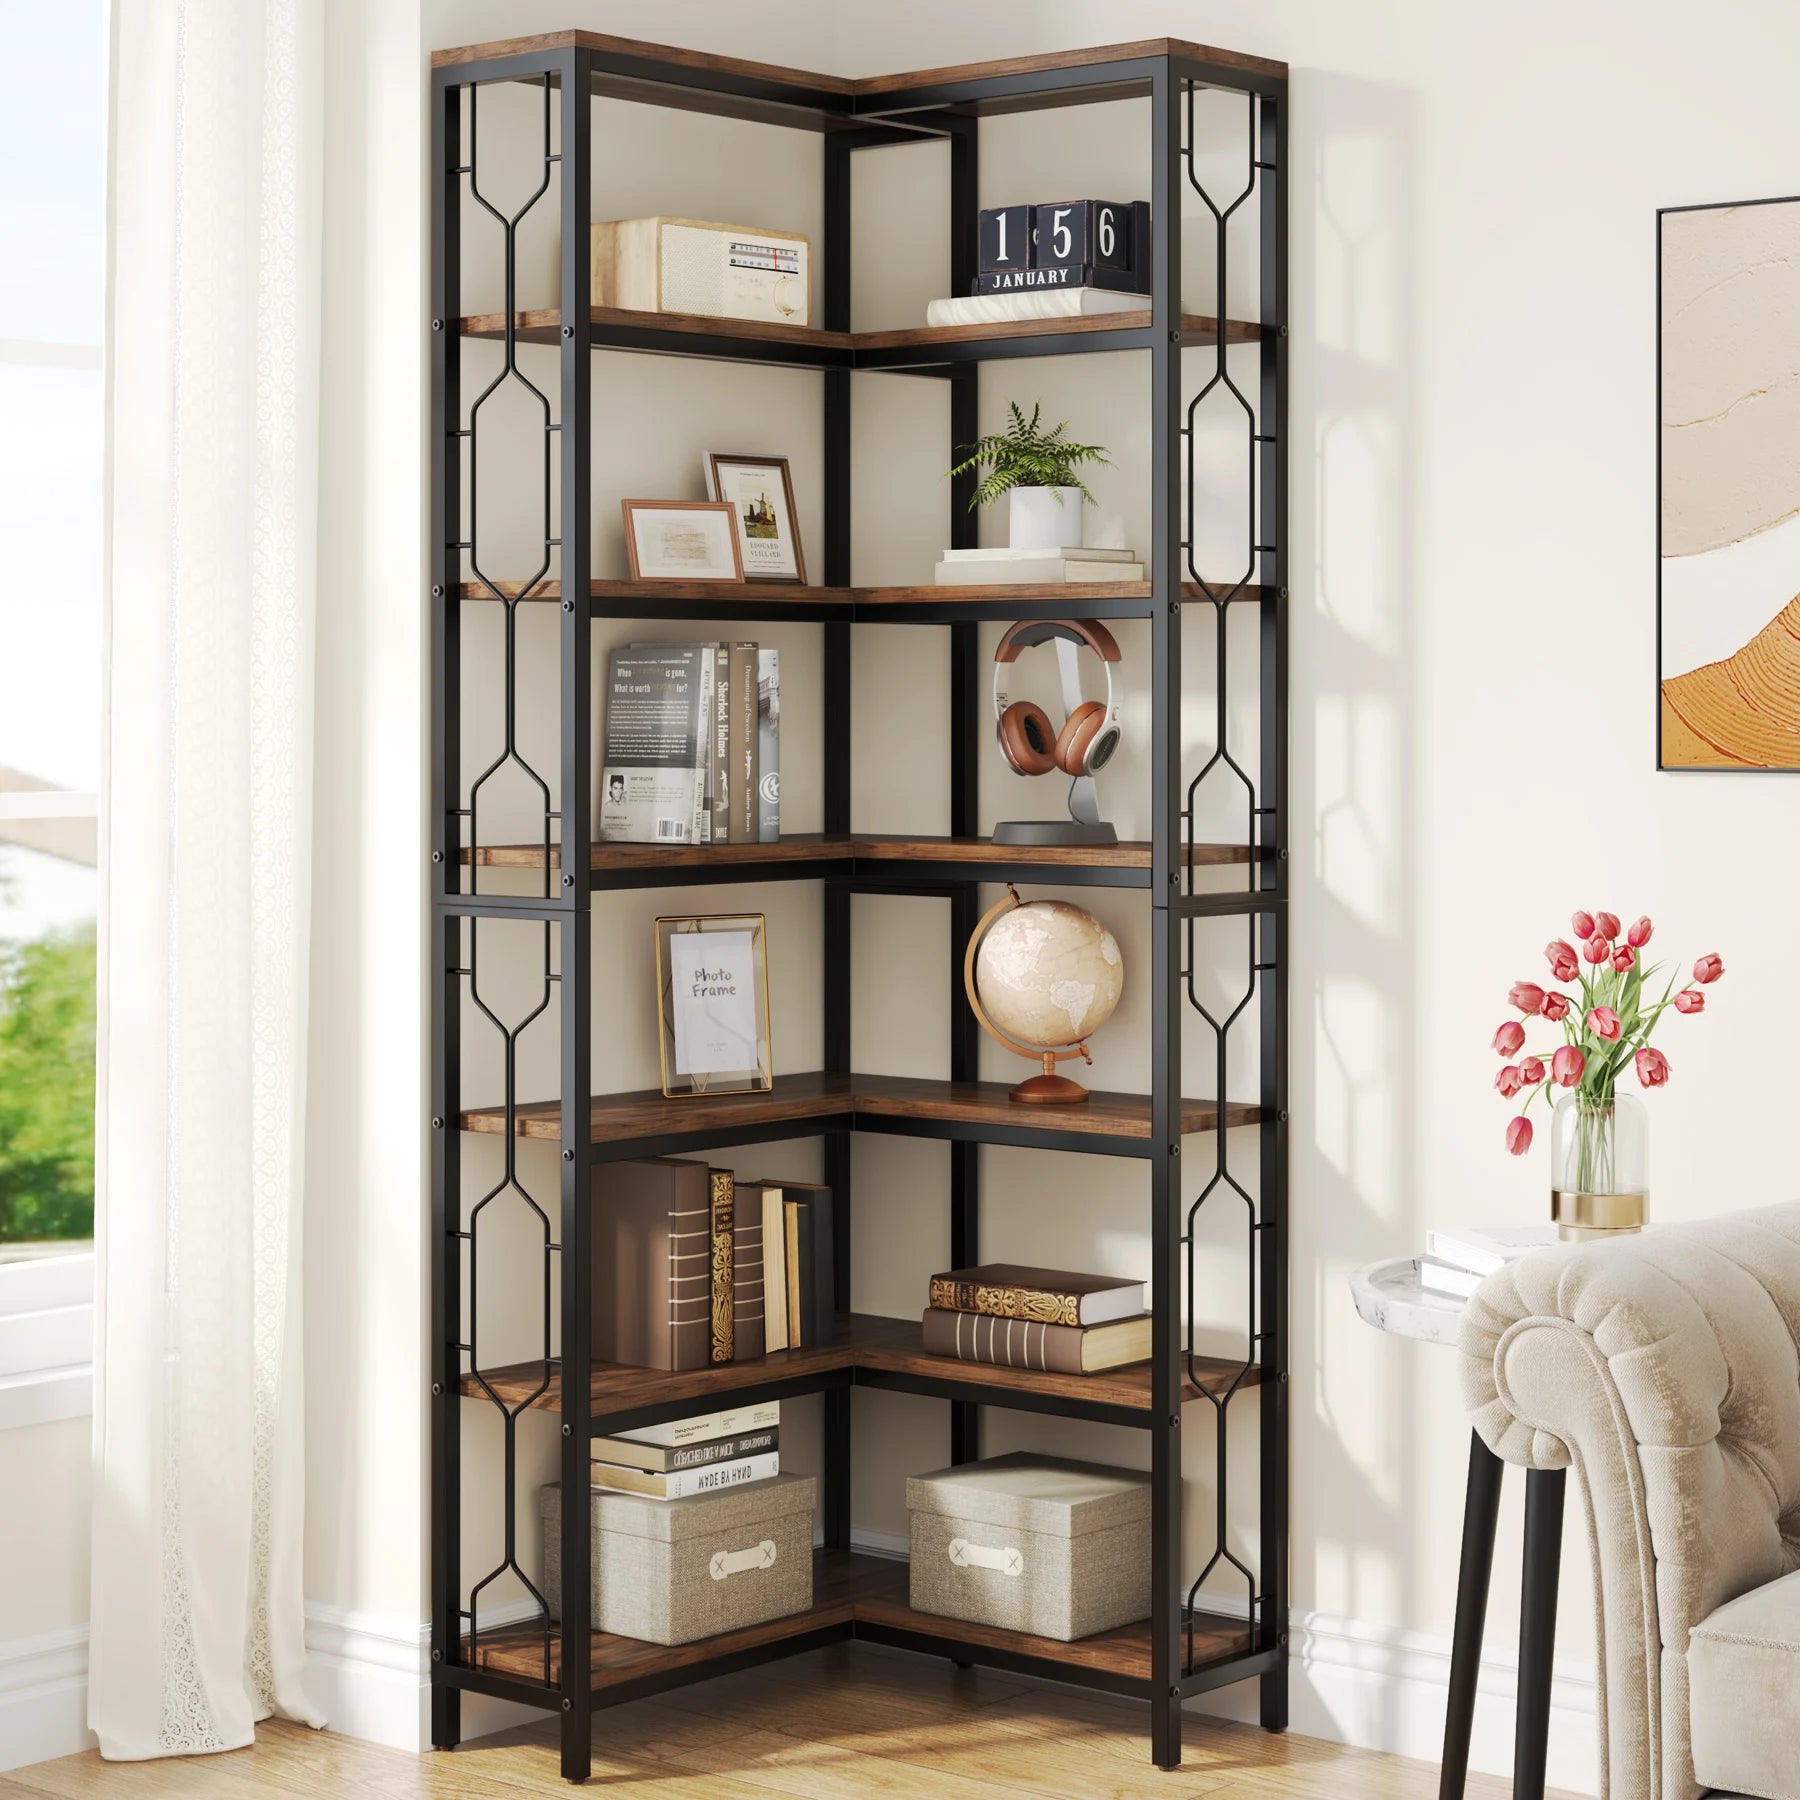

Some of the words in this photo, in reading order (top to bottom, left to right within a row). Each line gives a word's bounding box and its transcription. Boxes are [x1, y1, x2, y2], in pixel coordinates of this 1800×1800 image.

[996, 212, 1009, 261] 1
[1053, 208, 1072, 258] 5
[1099, 208, 1115, 257] 6
[992, 268, 1069, 289] JANUARY
[617, 668, 632, 677] When
[665, 668, 671, 677] is
[671, 669, 687, 679] gone,
[614, 684, 628, 693] What
[628, 683, 634, 693] is
[635, 683, 651, 693] worth
[744, 665, 752, 702] Dreaming
[717, 681, 728, 721] Sherlock
[745, 703, 752, 712] of
[717, 724, 728, 758] Holmes
[694, 967, 732, 982] Photo
[692, 984, 737, 997] Frame
